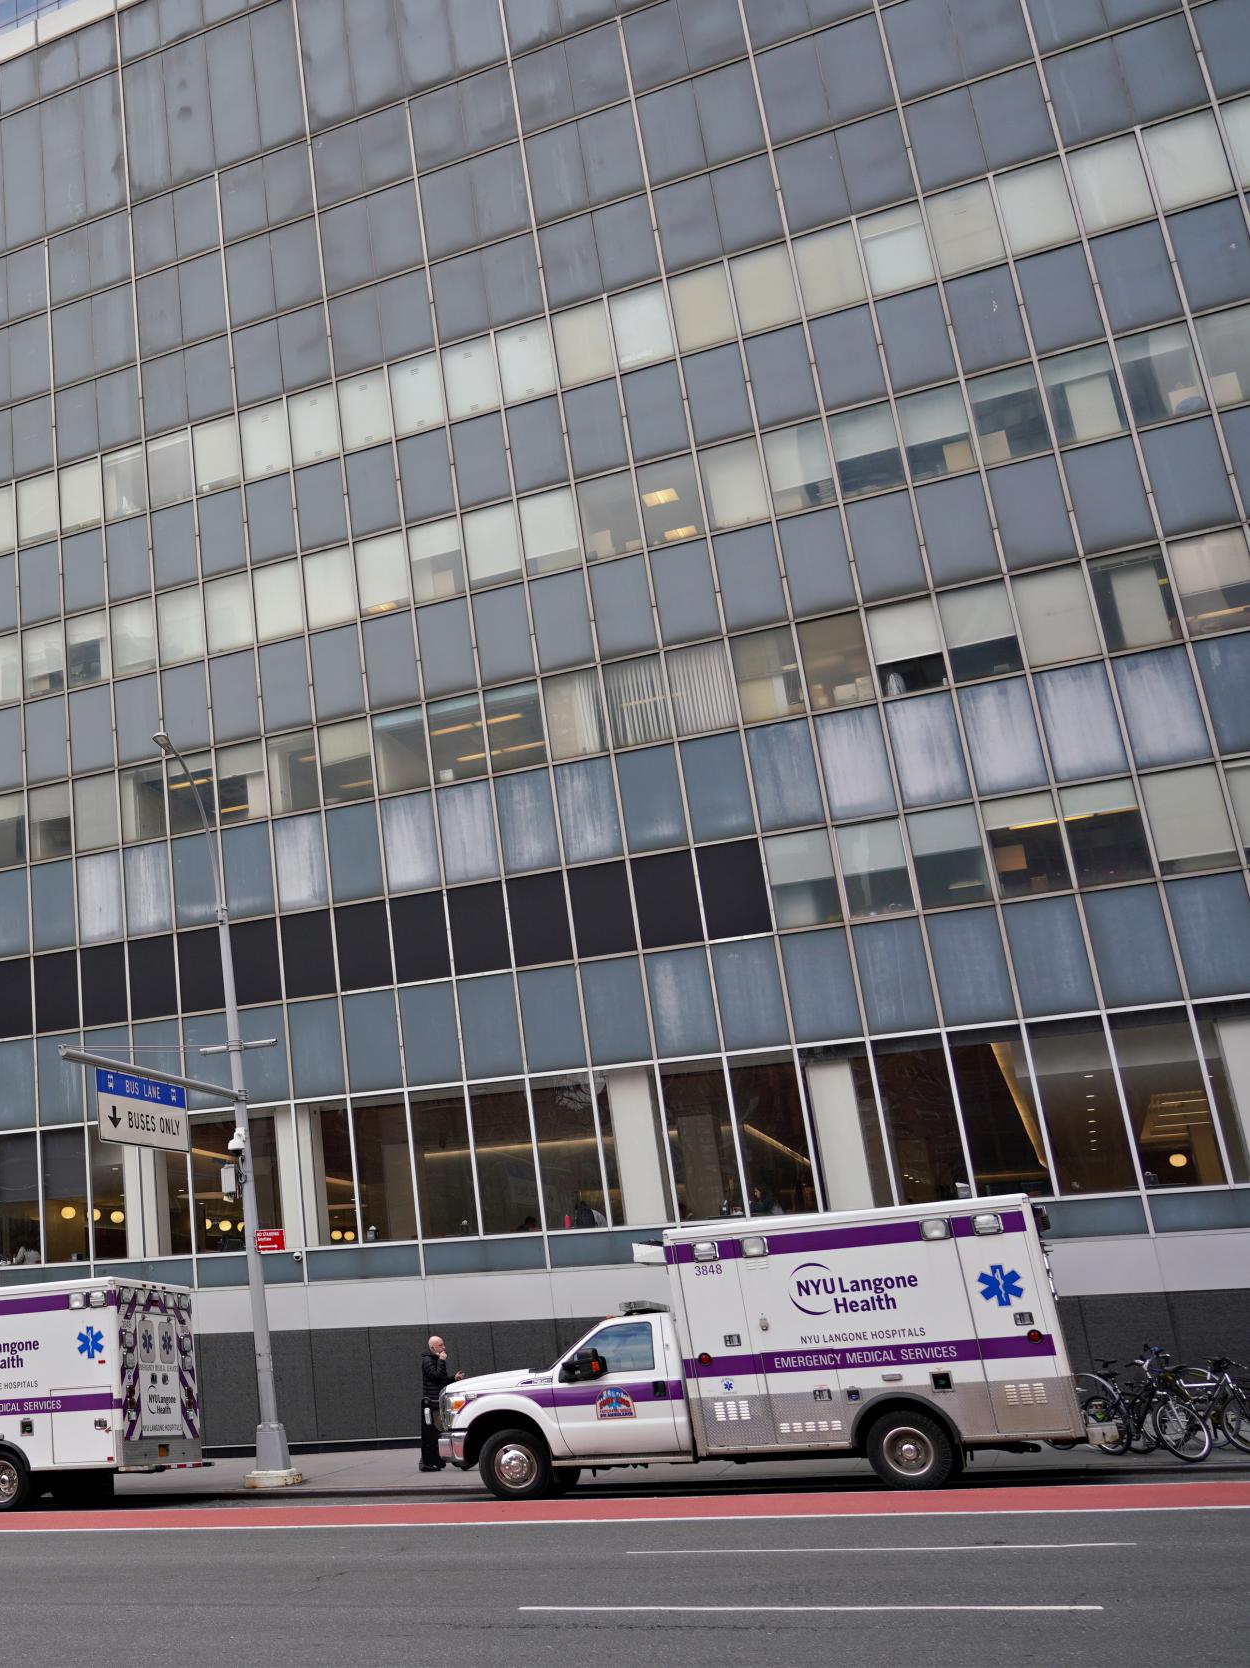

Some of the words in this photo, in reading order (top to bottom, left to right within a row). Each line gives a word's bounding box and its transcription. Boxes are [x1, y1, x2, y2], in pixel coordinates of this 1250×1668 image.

[125, 1079, 140, 1096] BUS
[143, 1083, 162, 1100] LANE
[127, 1111, 157, 1133] BUSES
[159, 1116, 181, 1137] ONLY
[694, 1264, 723, 1277] 3848
[796, 1277, 836, 1297] NYU
[838, 1273, 919, 1294] Langone
[833, 1293, 898, 1314] Health
[800, 1334, 821, 1345] NYU
[822, 1331, 869, 1343] LANGONE
[870, 1327, 926, 1340] HOSPITALS
[774, 1353, 842, 1369] EMERGENCY
[846, 1350, 897, 1364] MEDICAL
[900, 1345, 958, 1361] SERVICES
[4, 1380, 39, 1390] HOSPITALS
[23, 1400, 62, 1411] SERVICES
[148, 1394, 158, 1404] NYU
[158, 1395, 176, 1405] Langone
[156, 1405, 172, 1414] Health
